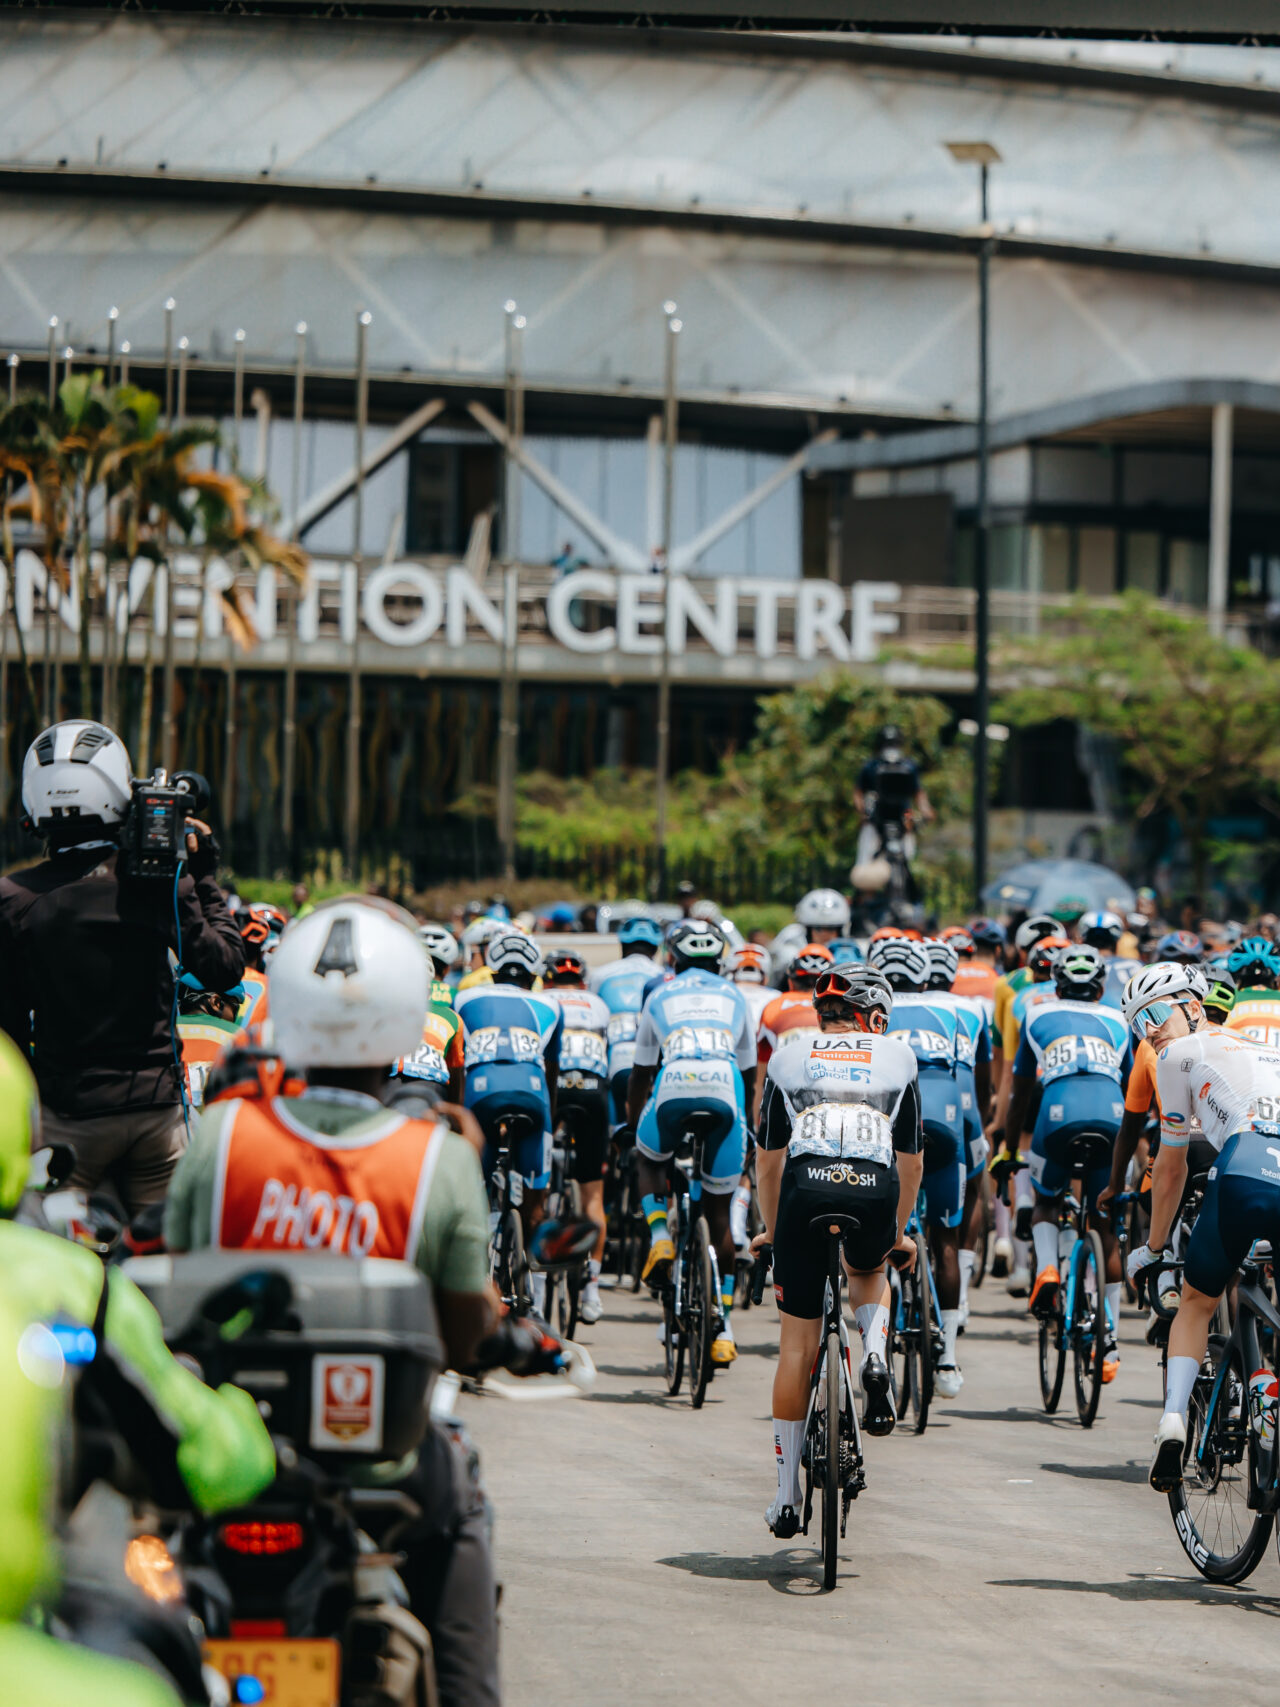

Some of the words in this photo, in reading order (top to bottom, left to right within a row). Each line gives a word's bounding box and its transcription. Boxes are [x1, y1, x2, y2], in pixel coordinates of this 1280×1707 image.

[0, 548, 518, 650] NVENTION
[812, 1039, 873, 1051] UAE
[665, 1071, 731, 1085] PASCAL
[253, 1177, 379, 1260] PHOTO
